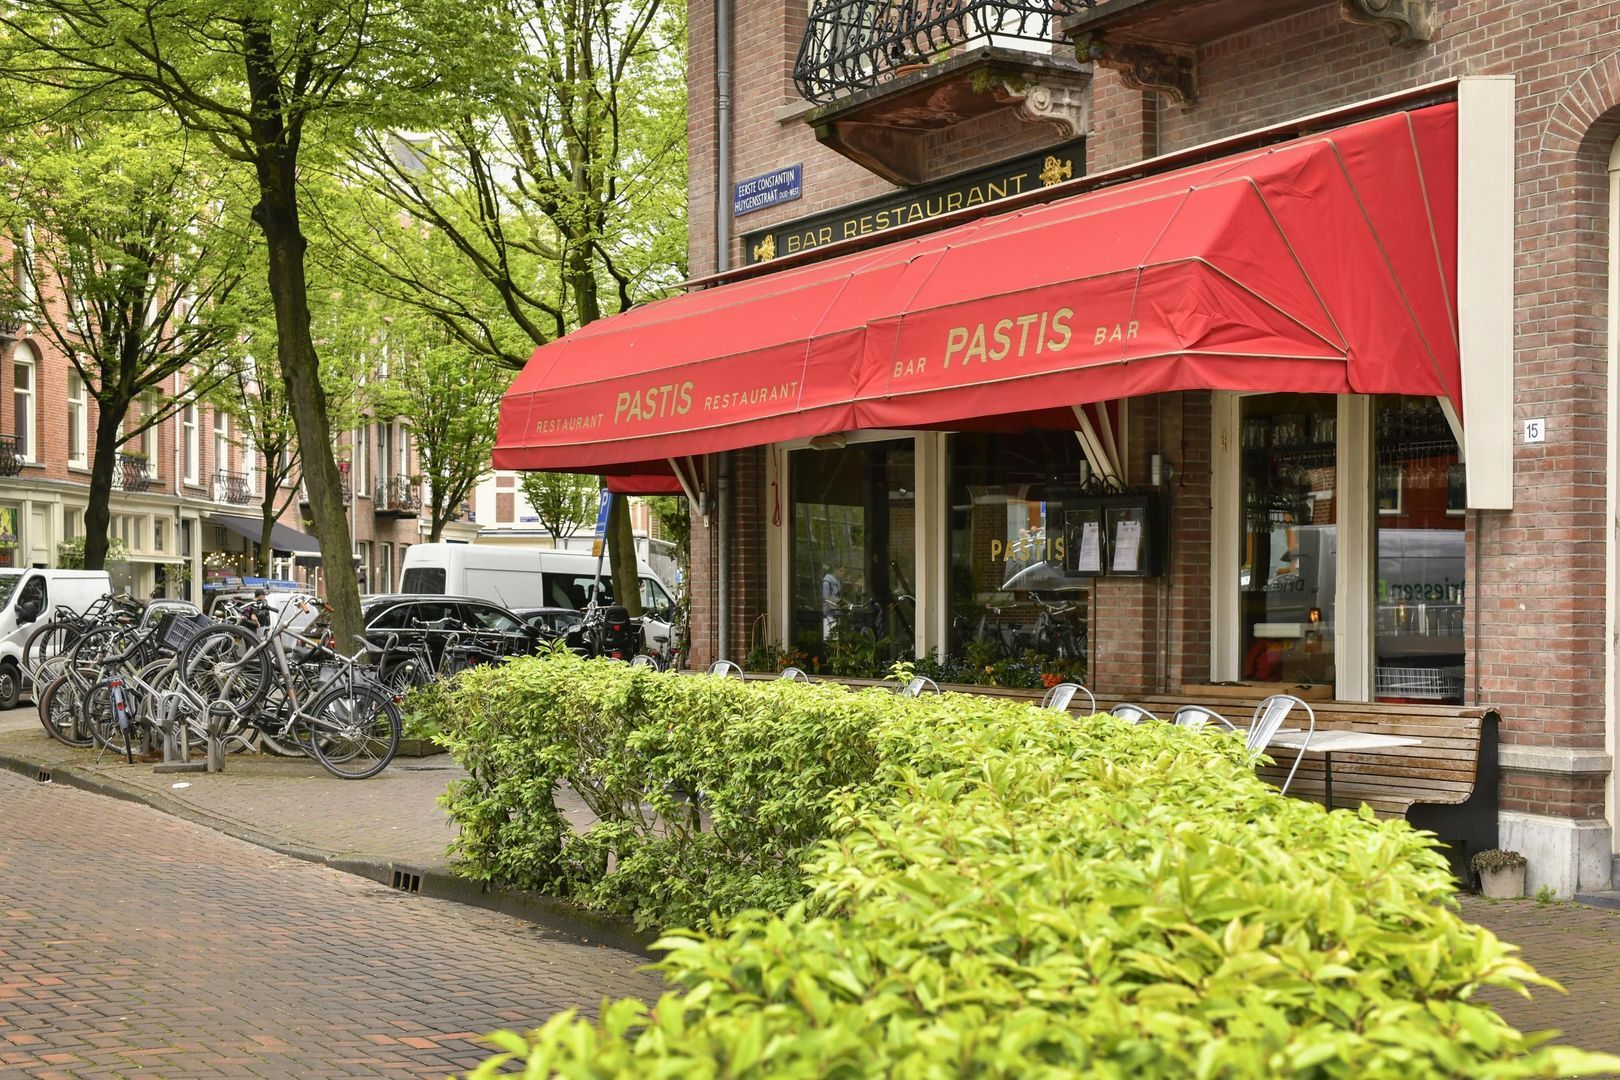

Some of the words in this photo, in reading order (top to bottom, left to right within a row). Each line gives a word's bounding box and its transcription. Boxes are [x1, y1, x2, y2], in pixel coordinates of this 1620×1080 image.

[738, 181, 757, 198] EERSTE
[757, 169, 795, 191] CONSTANTIJN
[734, 188, 778, 213] HUYGENSSTRAAT
[778, 187, 800, 200] OUD-WEST
[787, 226, 833, 253] BAR
[844, 173, 1029, 239] RESTAURANT
[893, 357, 927, 378] BAR
[943, 307, 1074, 369] PASTIS
[1093, 320, 1140, 346] BAR
[536, 413, 604, 433] RESTAURANT
[613, 381, 695, 425] PASTIS
[704, 381, 799, 412] RESTAURANT
[1526, 423, 1538, 439] 15
[600, 491, 609, 515] P
[991, 535, 1065, 562] PASTIS
